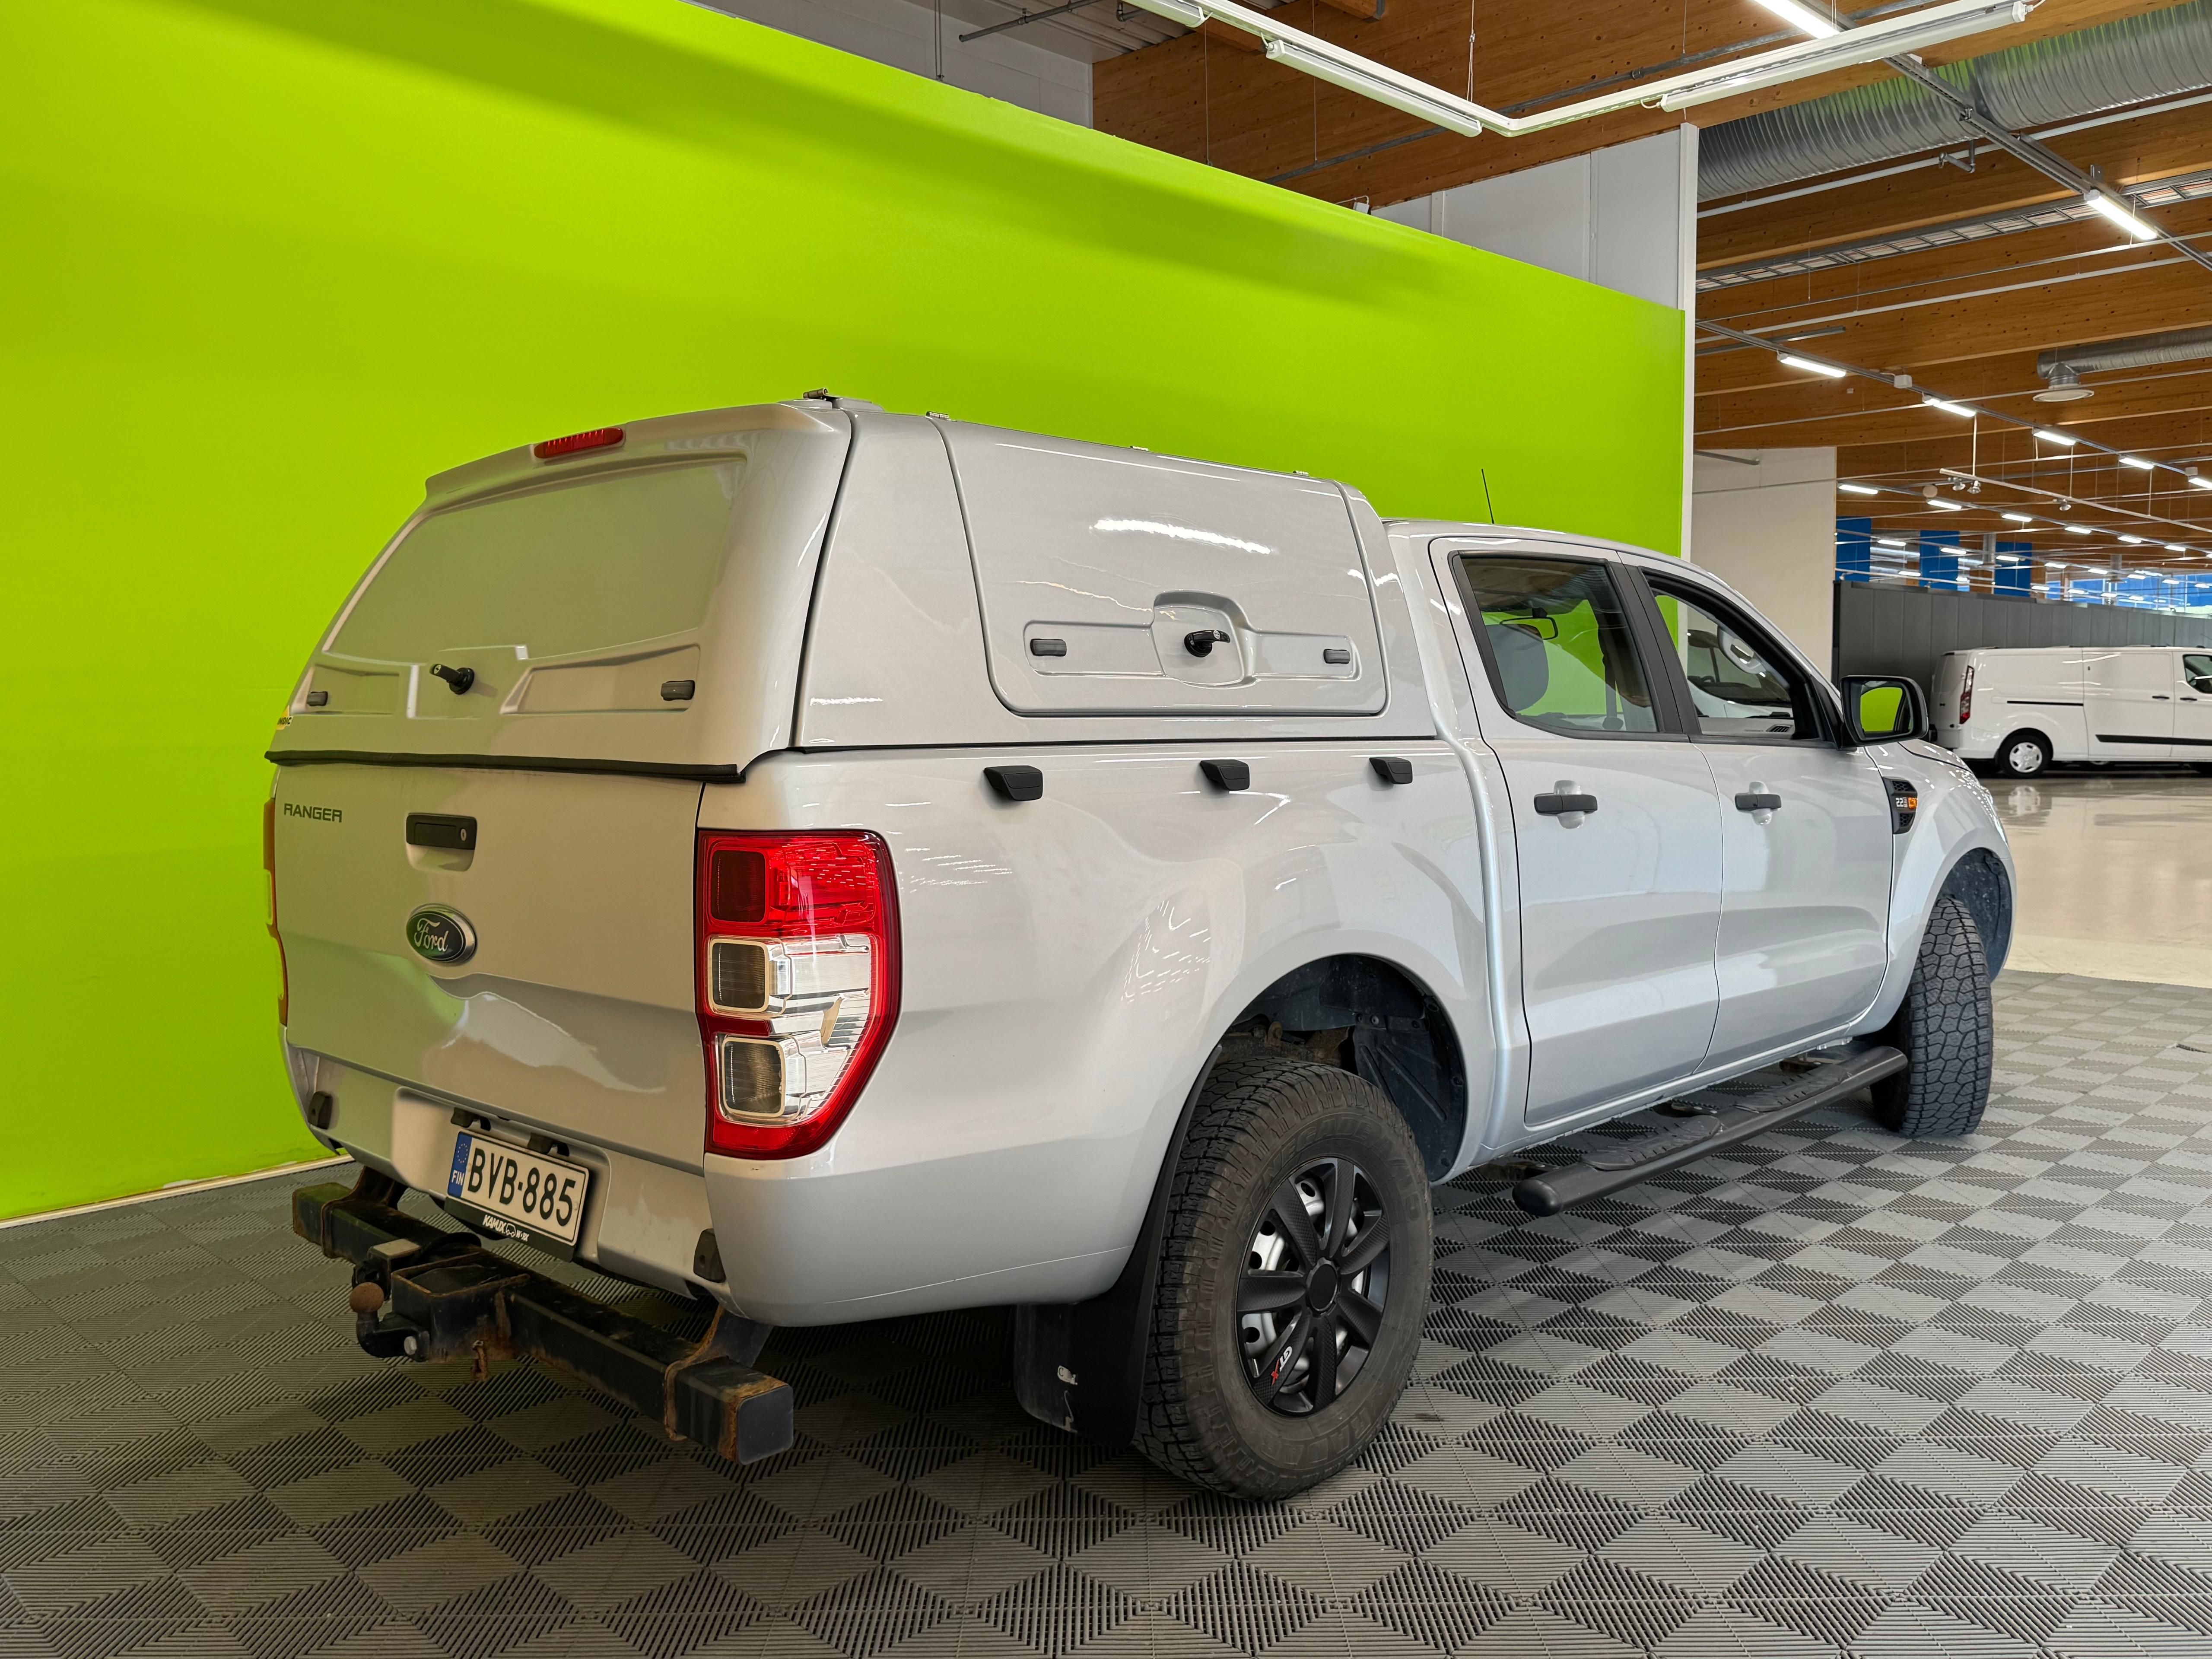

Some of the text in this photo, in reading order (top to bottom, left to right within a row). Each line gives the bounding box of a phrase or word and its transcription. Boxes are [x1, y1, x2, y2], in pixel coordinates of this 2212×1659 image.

[283, 803, 343, 823] RANGER
[414, 918, 449, 953] Ford
[451, 1170, 465, 1186] FIN
[467, 1147, 576, 1227] BVB-885
[483, 1214, 506, 1233] KAMUX
